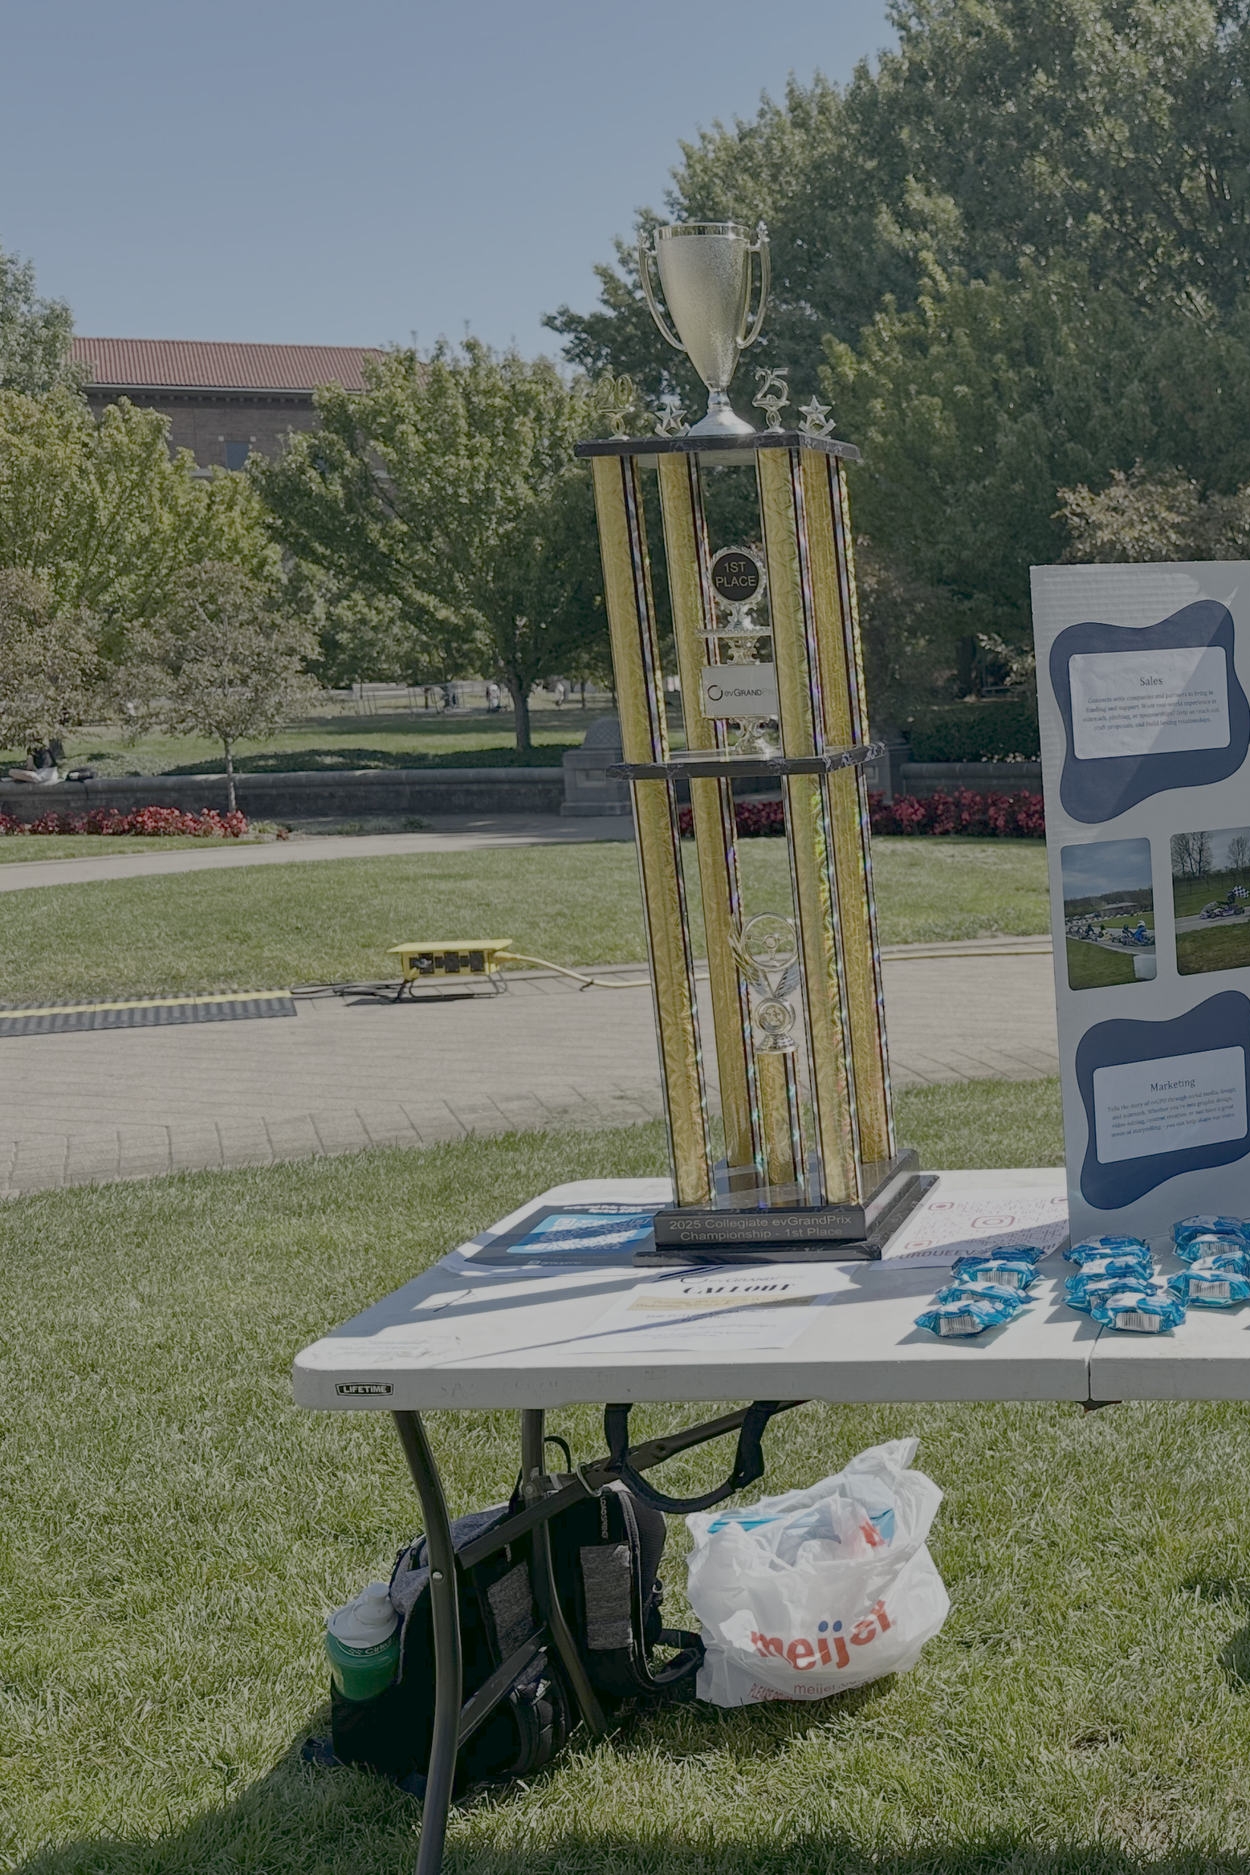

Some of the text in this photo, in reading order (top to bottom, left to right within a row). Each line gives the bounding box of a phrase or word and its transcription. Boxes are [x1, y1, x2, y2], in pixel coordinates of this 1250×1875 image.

[724, 562, 746, 573] 1ST
[716, 575, 756, 587] PLACE
[1140, 676, 1163, 686] Sales
[1150, 1079, 1196, 1092] Marketing
[669, 1216, 851, 1230] 2025 Collegiate evGrandPrix
[680, 1230, 771, 1242] Championship
[785, 1229, 803, 1237] 1st
[807, 1228, 843, 1237] Place
[684, 1284, 795, 1294] CALLOUT
[343, 1385, 387, 1393] LIFETIME
[751, 1599, 891, 1670] meijer
